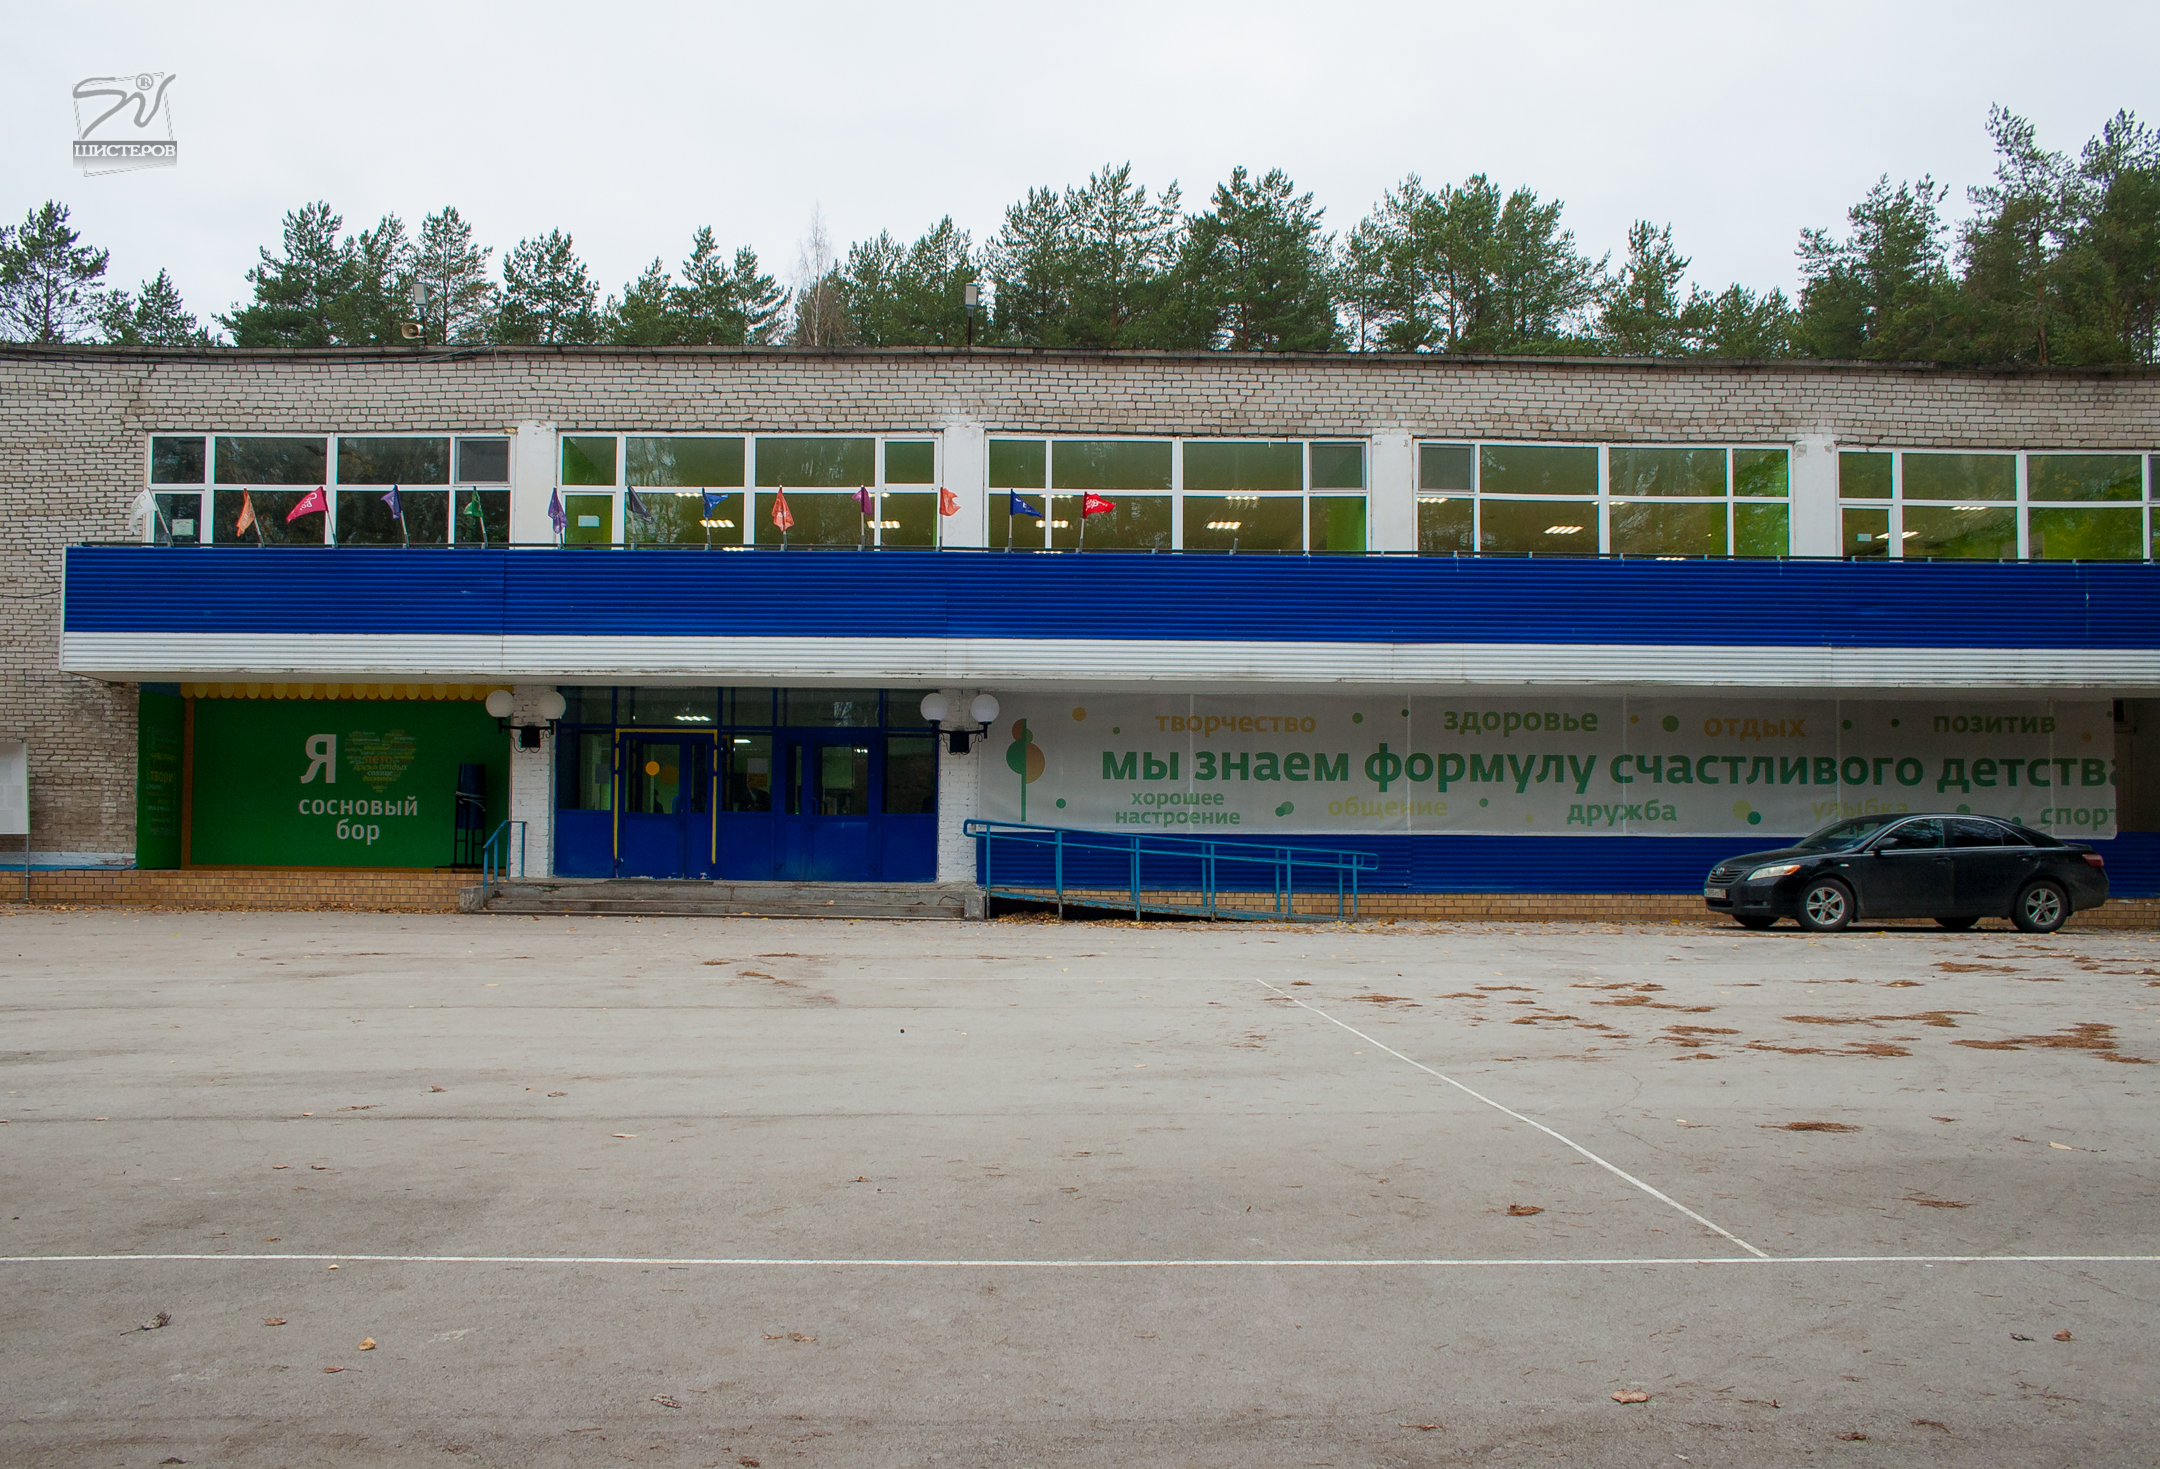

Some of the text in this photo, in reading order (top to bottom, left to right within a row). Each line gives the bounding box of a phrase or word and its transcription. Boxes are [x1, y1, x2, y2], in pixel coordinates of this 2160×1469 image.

[1155, 714, 1315, 737] творчество
[1443, 711, 1598, 738] здоровье
[1704, 717, 1805, 742] отдых
[1934, 715, 2057, 736] позитив
[300, 734, 337, 783] Я
[365, 755, 393, 764] лето
[1102, 751, 1178, 780] мы
[1194, 751, 1348, 781] знаем
[1364, 743, 1596, 794] формулу
[1609, 754, 1924, 786] счастливого
[298, 796, 418, 816] сосновый
[1132, 792, 1225, 811] хорошее
[1328, 796, 1447, 819] общение
[1566, 798, 1677, 827] дружба
[1115, 810, 1241, 827] настроение
[336, 818, 380, 846] бор
